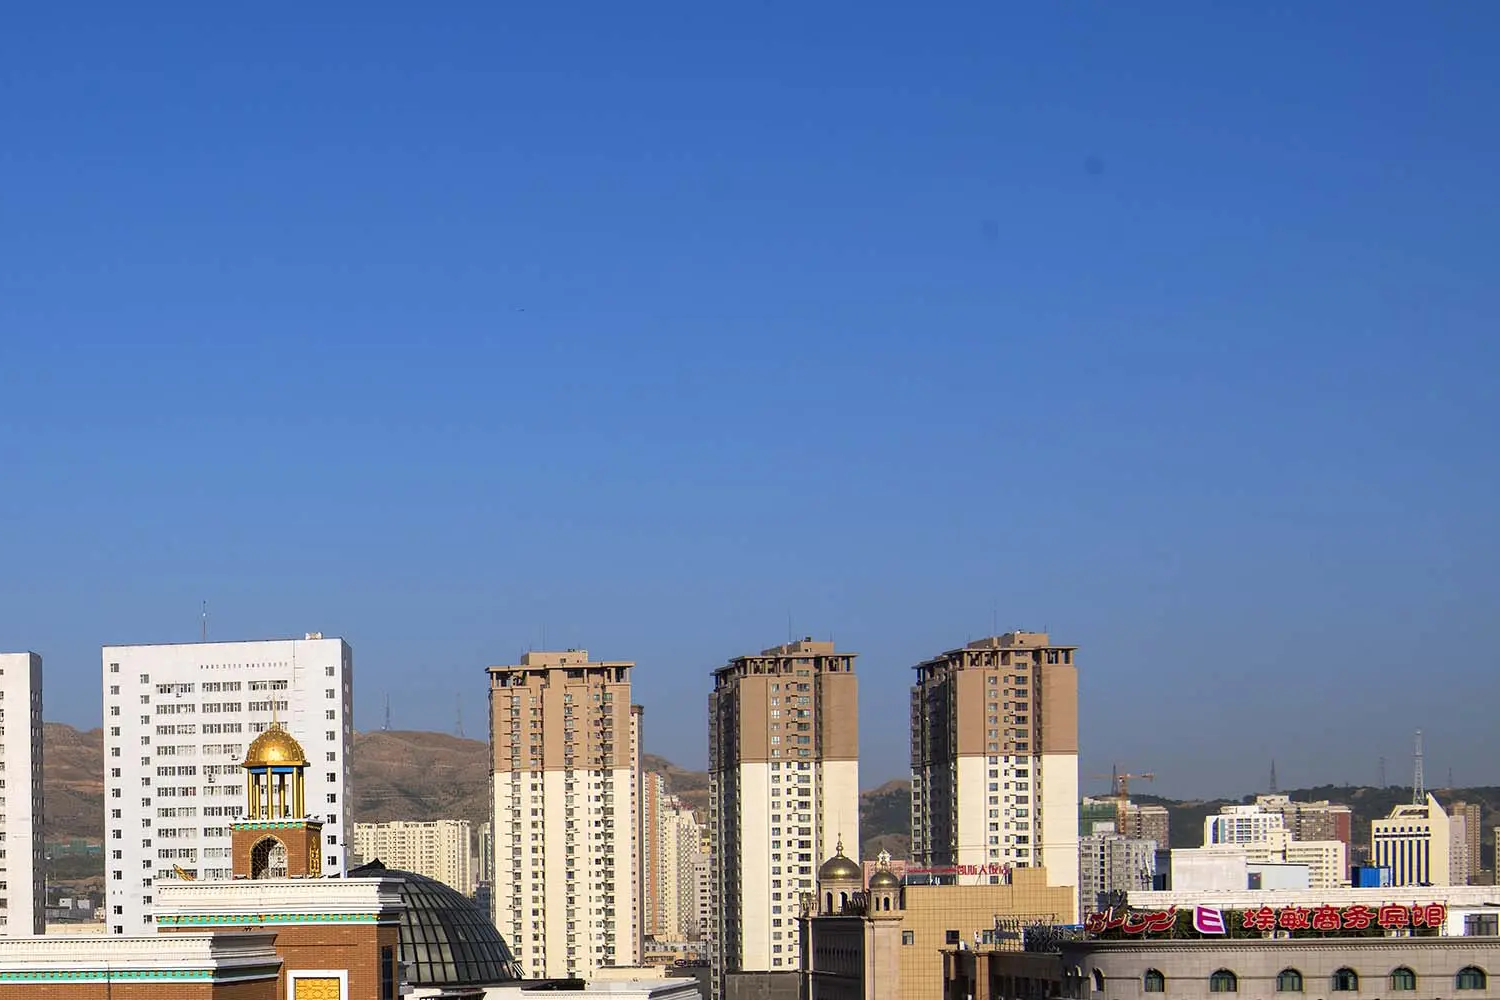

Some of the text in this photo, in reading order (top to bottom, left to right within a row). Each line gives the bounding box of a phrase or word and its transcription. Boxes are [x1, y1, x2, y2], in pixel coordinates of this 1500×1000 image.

[1243, 903, 1447, 929] 埃敏商务宾馆
